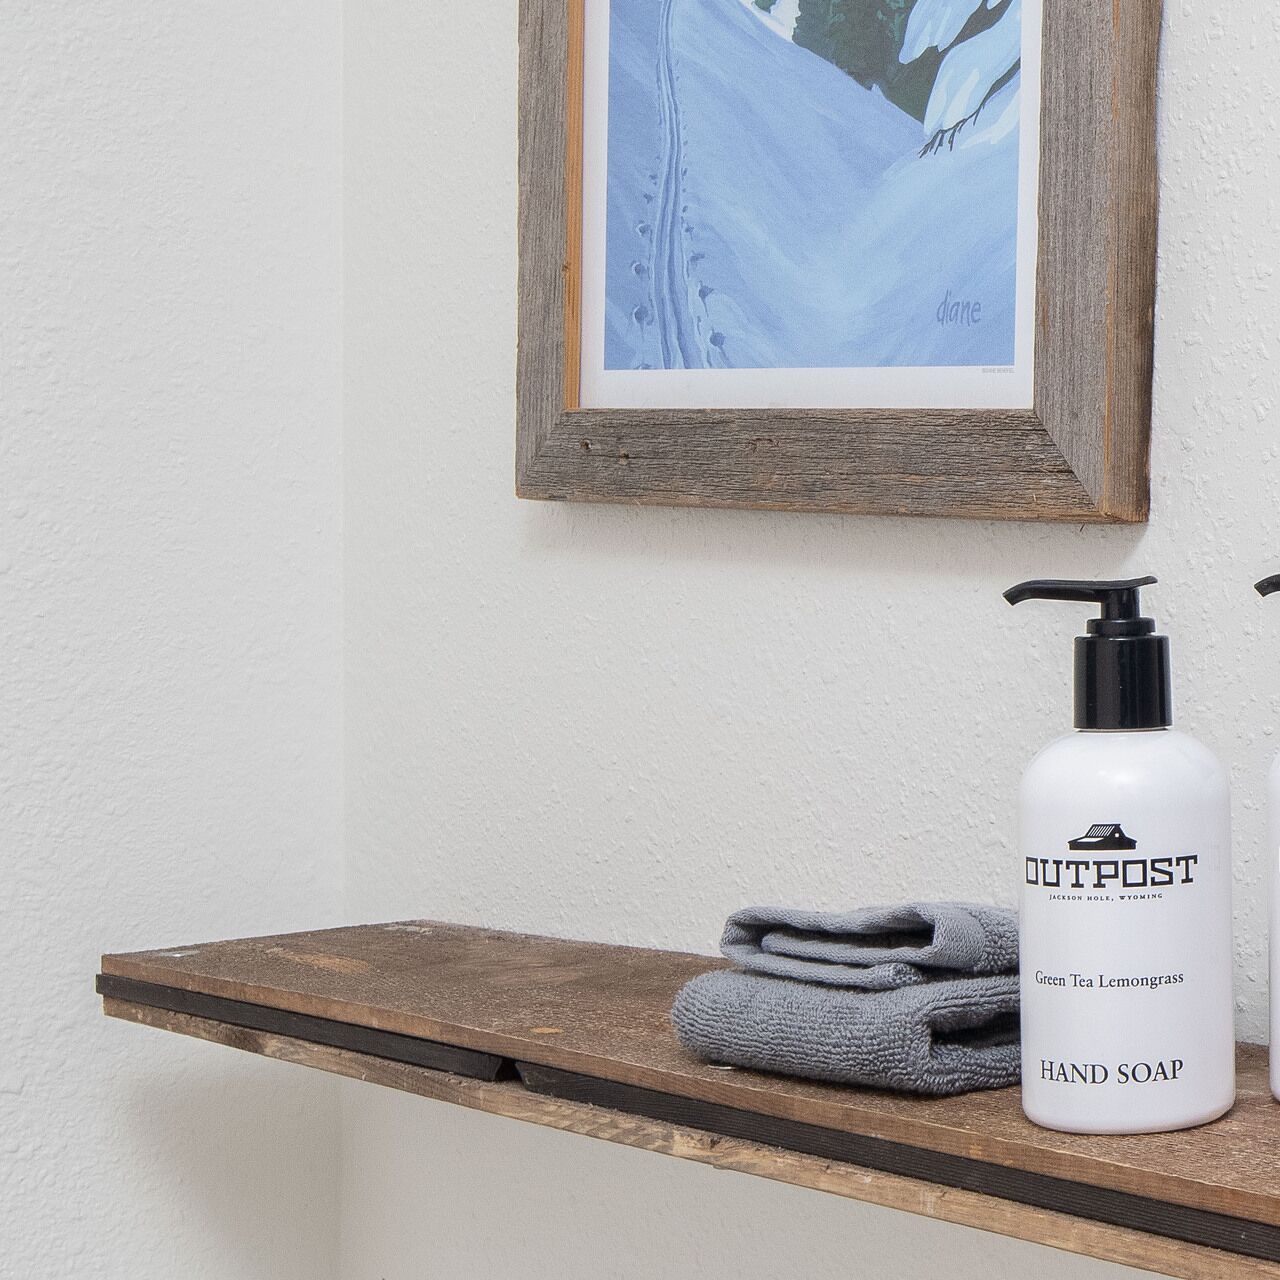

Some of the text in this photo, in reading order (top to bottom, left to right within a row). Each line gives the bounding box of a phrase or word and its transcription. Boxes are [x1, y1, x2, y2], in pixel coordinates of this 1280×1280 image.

[1025, 854, 1198, 888] OUTPOST
[1119, 893, 1163, 901] WYOMING
[1035, 970, 1184, 989] Green Tea Lemongrass
[1040, 1059, 1183, 1084] HAND SOAP
